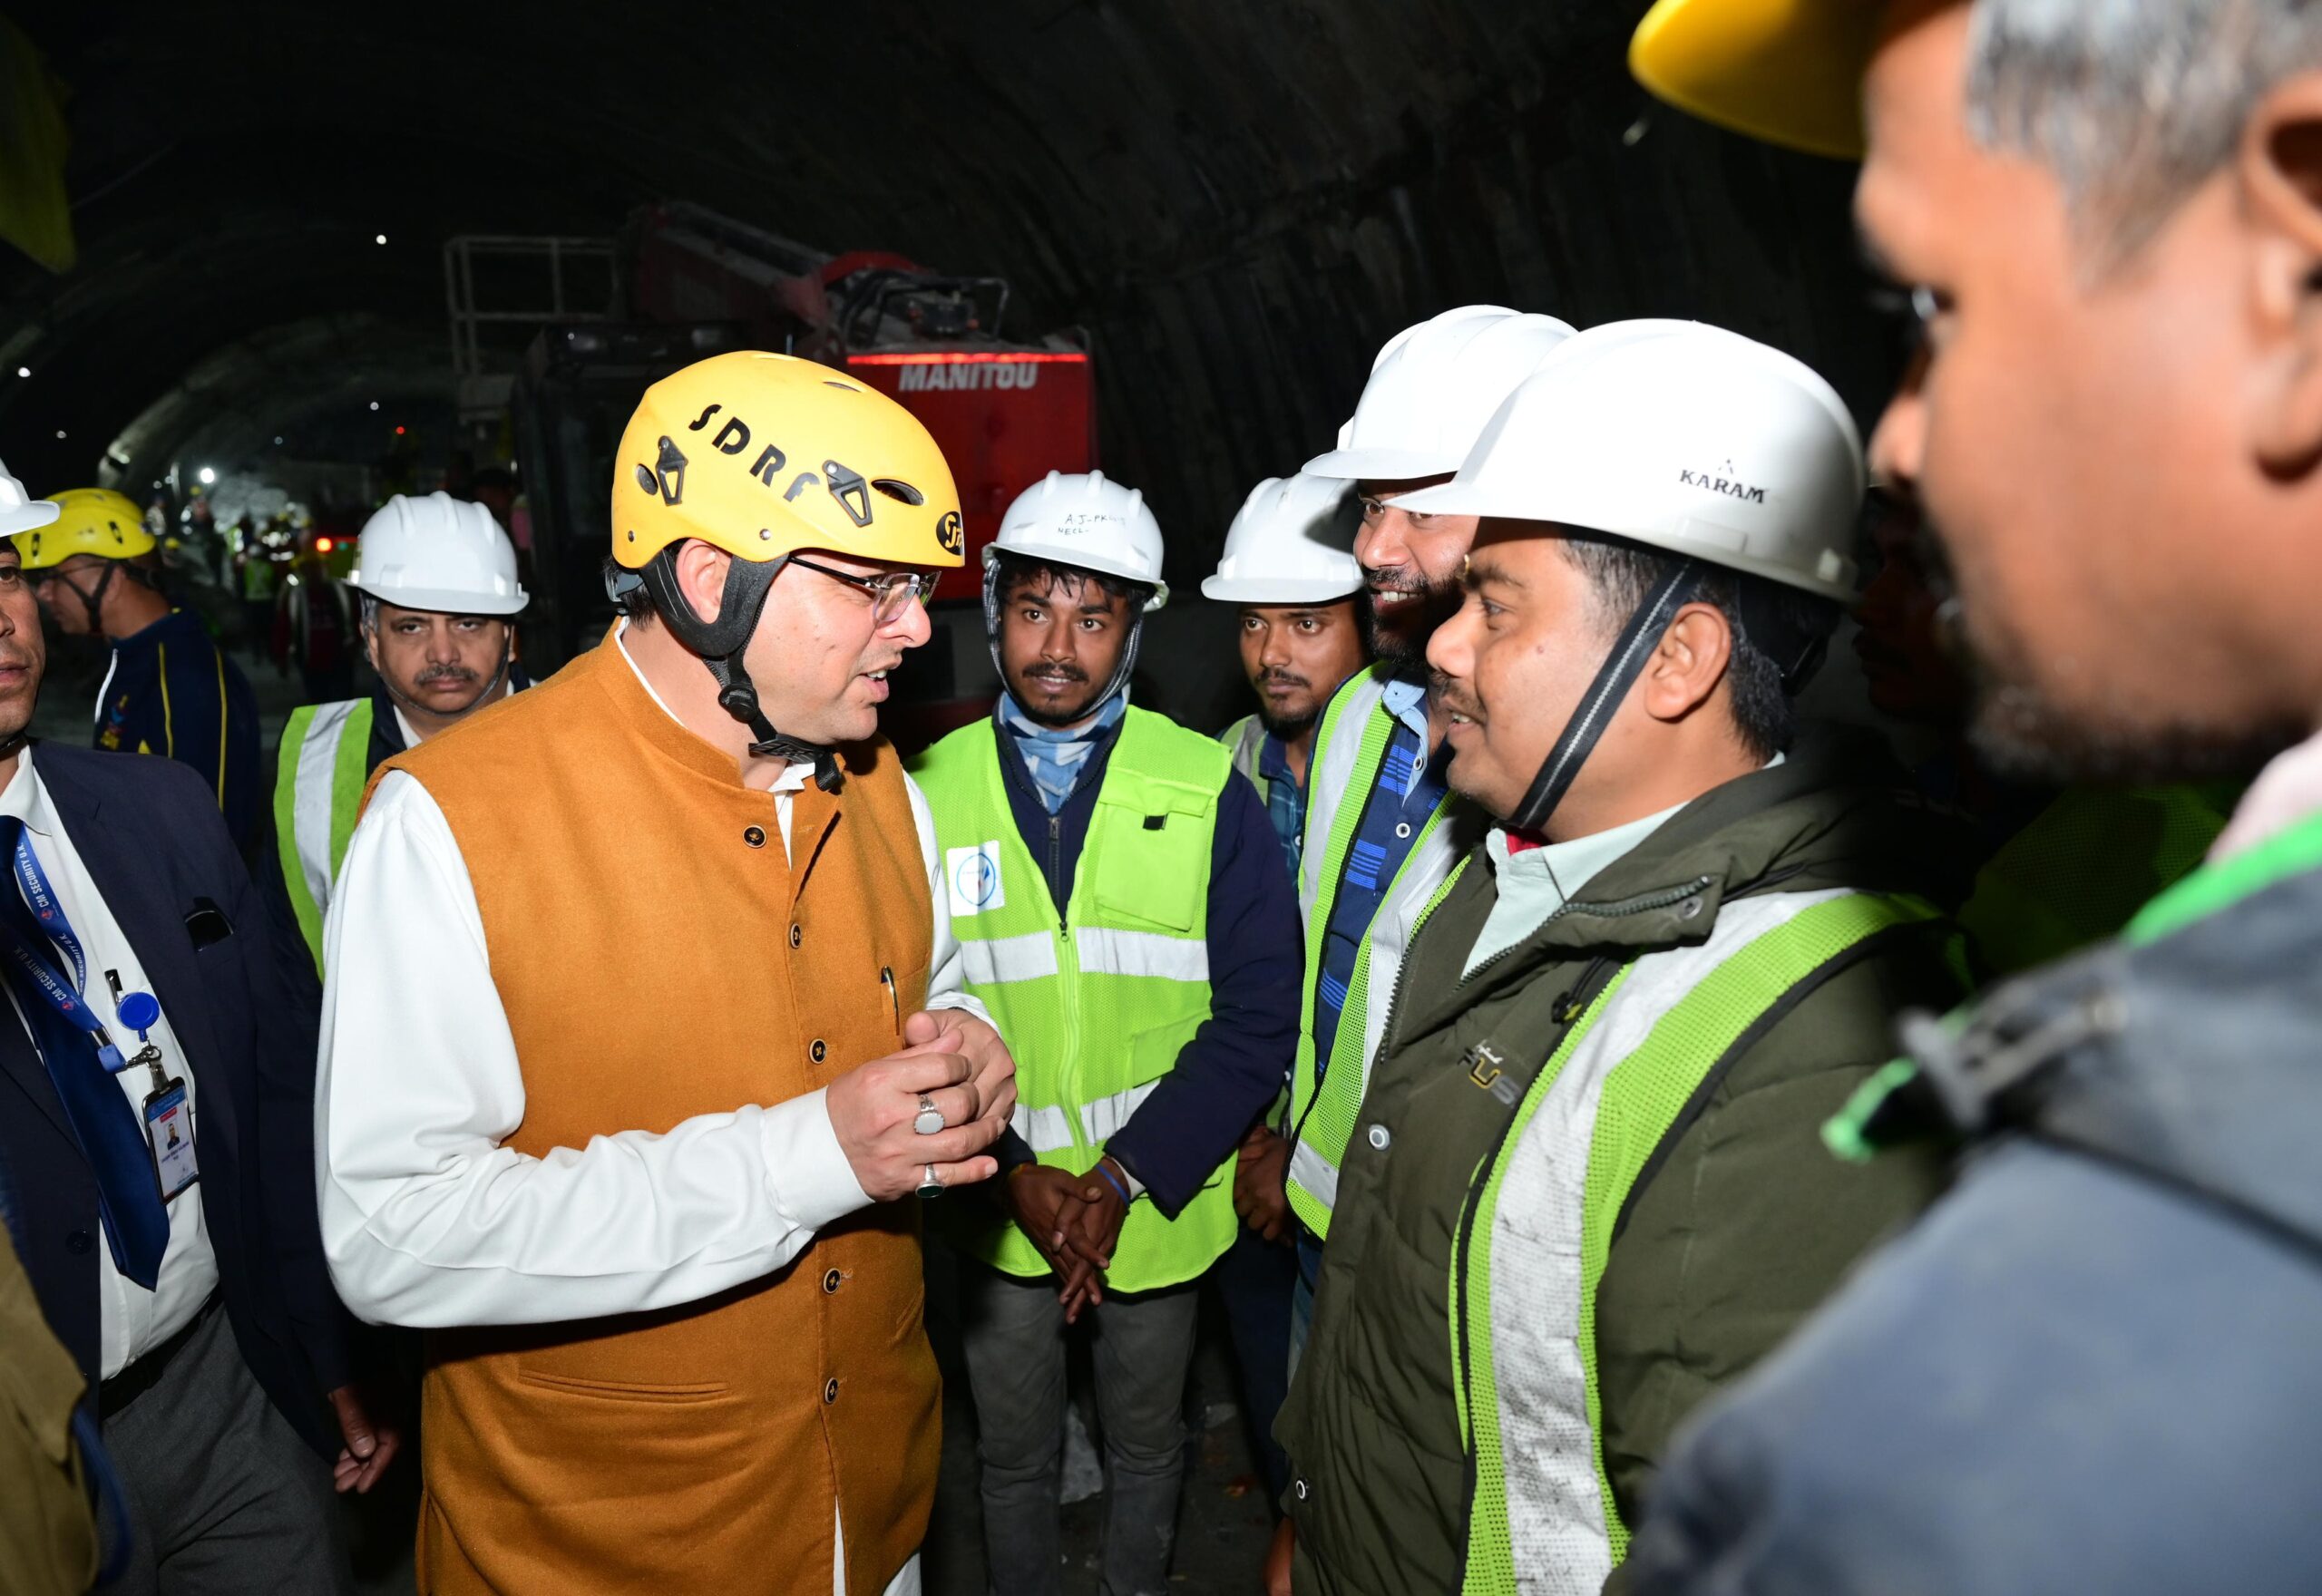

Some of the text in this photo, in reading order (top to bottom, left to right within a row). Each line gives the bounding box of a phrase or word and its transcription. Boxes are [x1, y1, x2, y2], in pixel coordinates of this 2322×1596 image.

[899, 362, 1039, 391] MANITOU
[688, 404, 820, 502] SDRF
[1679, 469, 1765, 503] KARAM
[21, 860, 43, 894] SECURITY
[36, 894, 50, 908] CM
[25, 959, 56, 990] SECURITY
[52, 988, 67, 1001] CM
